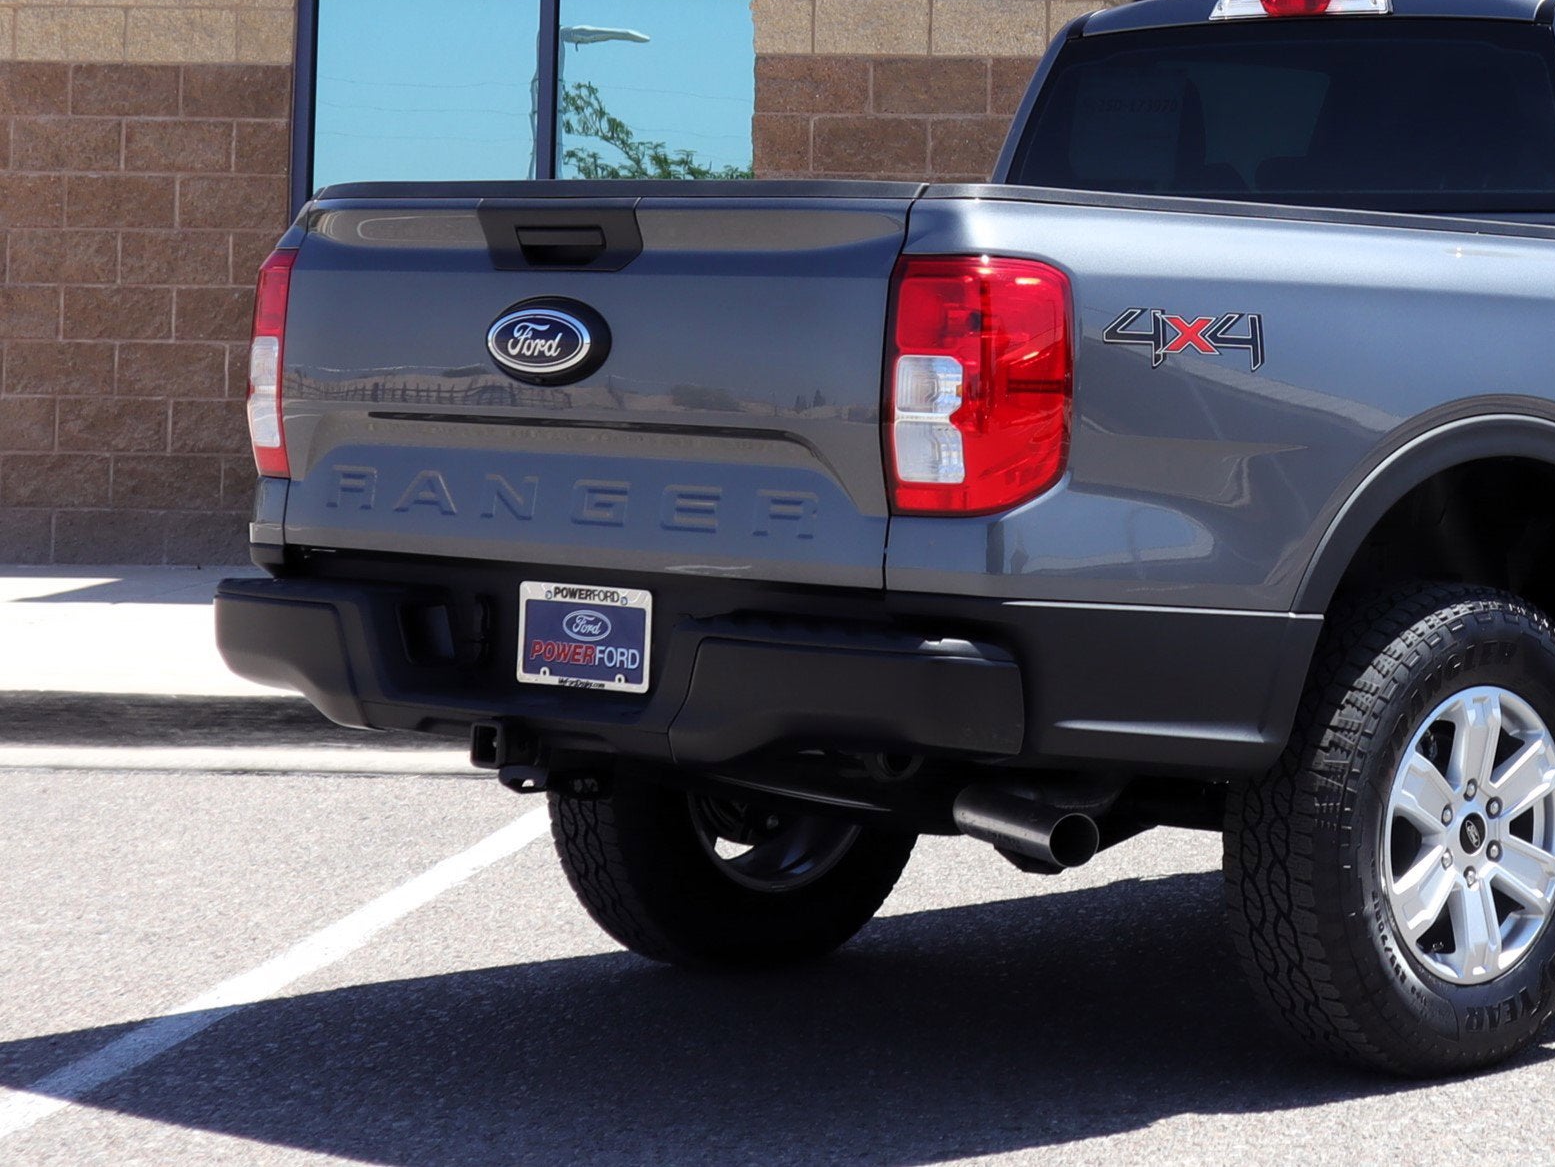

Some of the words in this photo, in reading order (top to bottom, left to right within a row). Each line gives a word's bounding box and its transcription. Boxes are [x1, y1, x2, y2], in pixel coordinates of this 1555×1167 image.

[507, 321, 563, 357] Ford
[325, 463, 822, 540] RANGER
[553, 586, 620, 603] POWERFORD
[572, 614, 602, 635] Ford
[530, 639, 640, 669] POWERFORD
